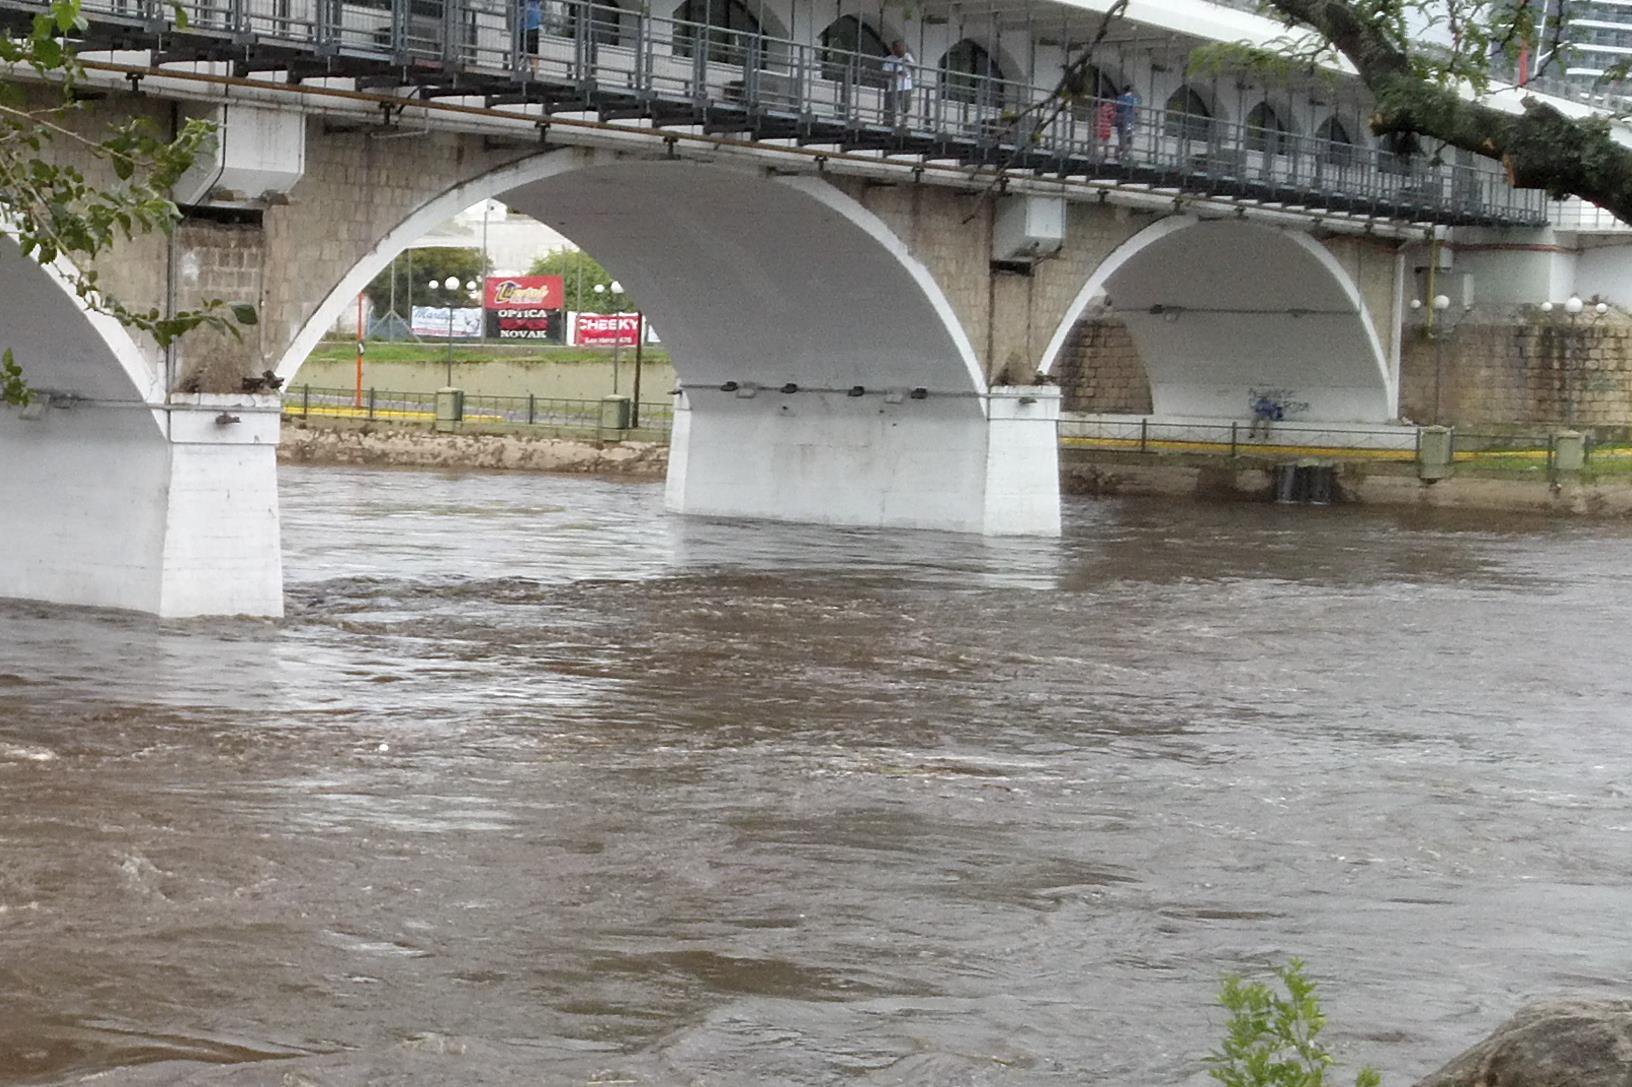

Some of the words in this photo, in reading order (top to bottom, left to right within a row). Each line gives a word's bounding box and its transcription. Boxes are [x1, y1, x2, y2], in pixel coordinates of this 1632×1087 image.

[498, 309, 547, 318] OPTICA
[579, 319, 638, 330] CHEEKY
[500, 330, 547, 338] NOVAK
